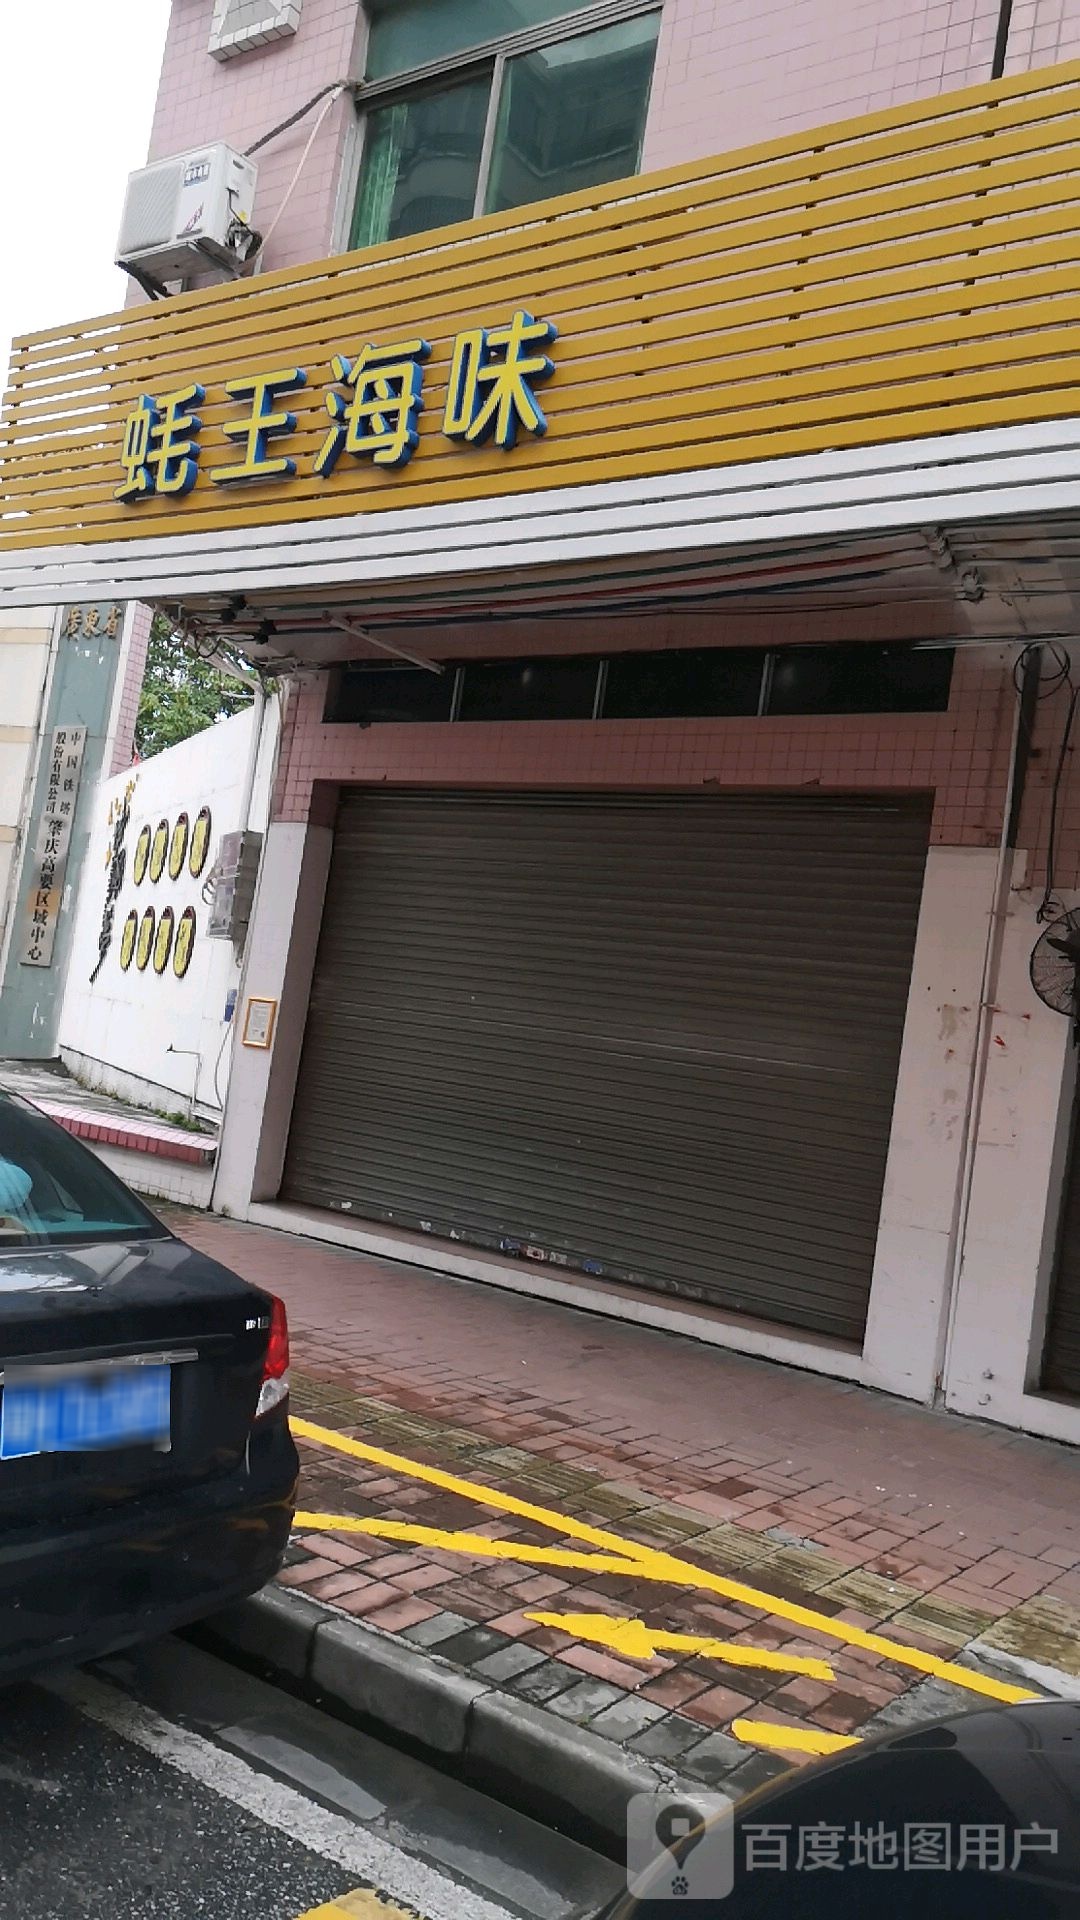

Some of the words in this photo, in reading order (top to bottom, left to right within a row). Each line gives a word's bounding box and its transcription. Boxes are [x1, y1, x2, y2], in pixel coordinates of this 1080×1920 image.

[112, 308, 559, 503] 蚝王海味
[46, 731, 67, 814] 股份有限公司
[60, 731, 82, 816] 中国铁塔
